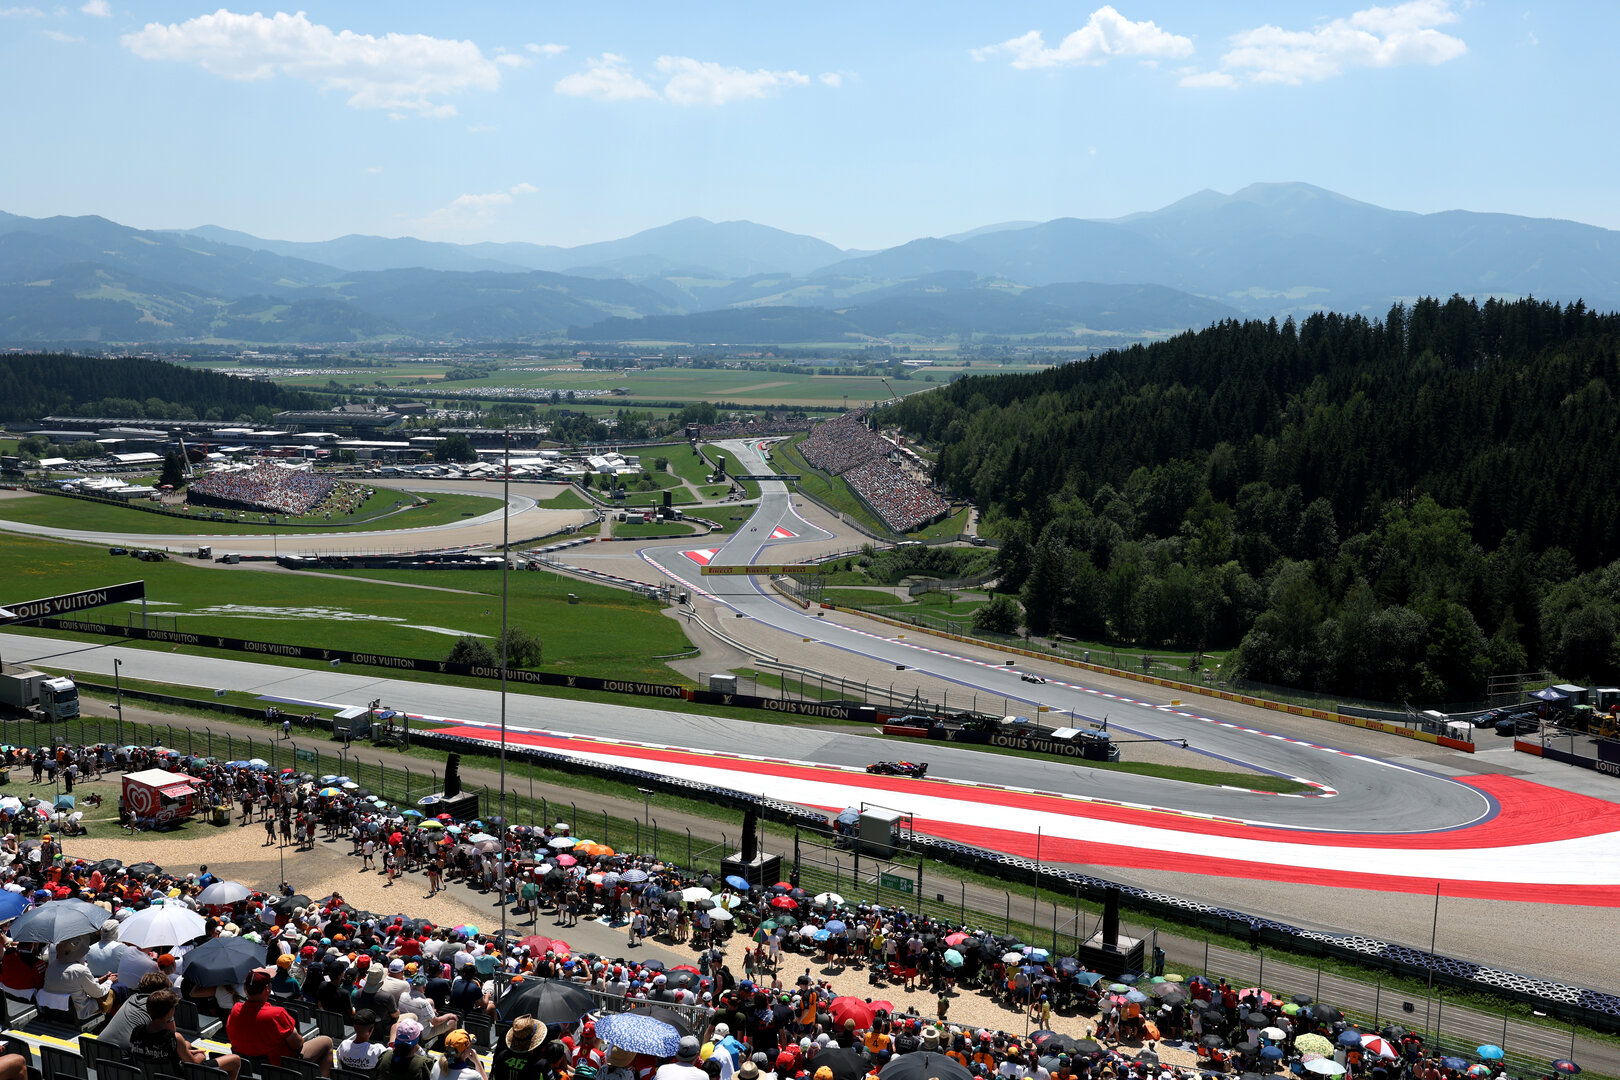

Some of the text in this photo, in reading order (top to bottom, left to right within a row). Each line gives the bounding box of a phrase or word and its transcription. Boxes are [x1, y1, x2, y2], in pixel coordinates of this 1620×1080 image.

[12, 591, 107, 620] LOUIS VUITTON
[60, 621, 106, 633] LOUIS VUITTON
[147, 630, 199, 643] LOUIS VUITTON
[244, 641, 301, 655] LOUIS VUITTON
[352, 653, 377, 664] LOUIS
[378, 656, 415, 668] VUITTON
[471, 666, 499, 678] LOUIS
[603, 680, 681, 697] LOUIS VUITTON
[763, 699, 849, 720] LOUIS VUITTON
[991, 734, 1085, 757] LOUIS VUITTON
[1596, 761, 1620, 775] LOUIS
[505, 1057, 528, 1070] 46
